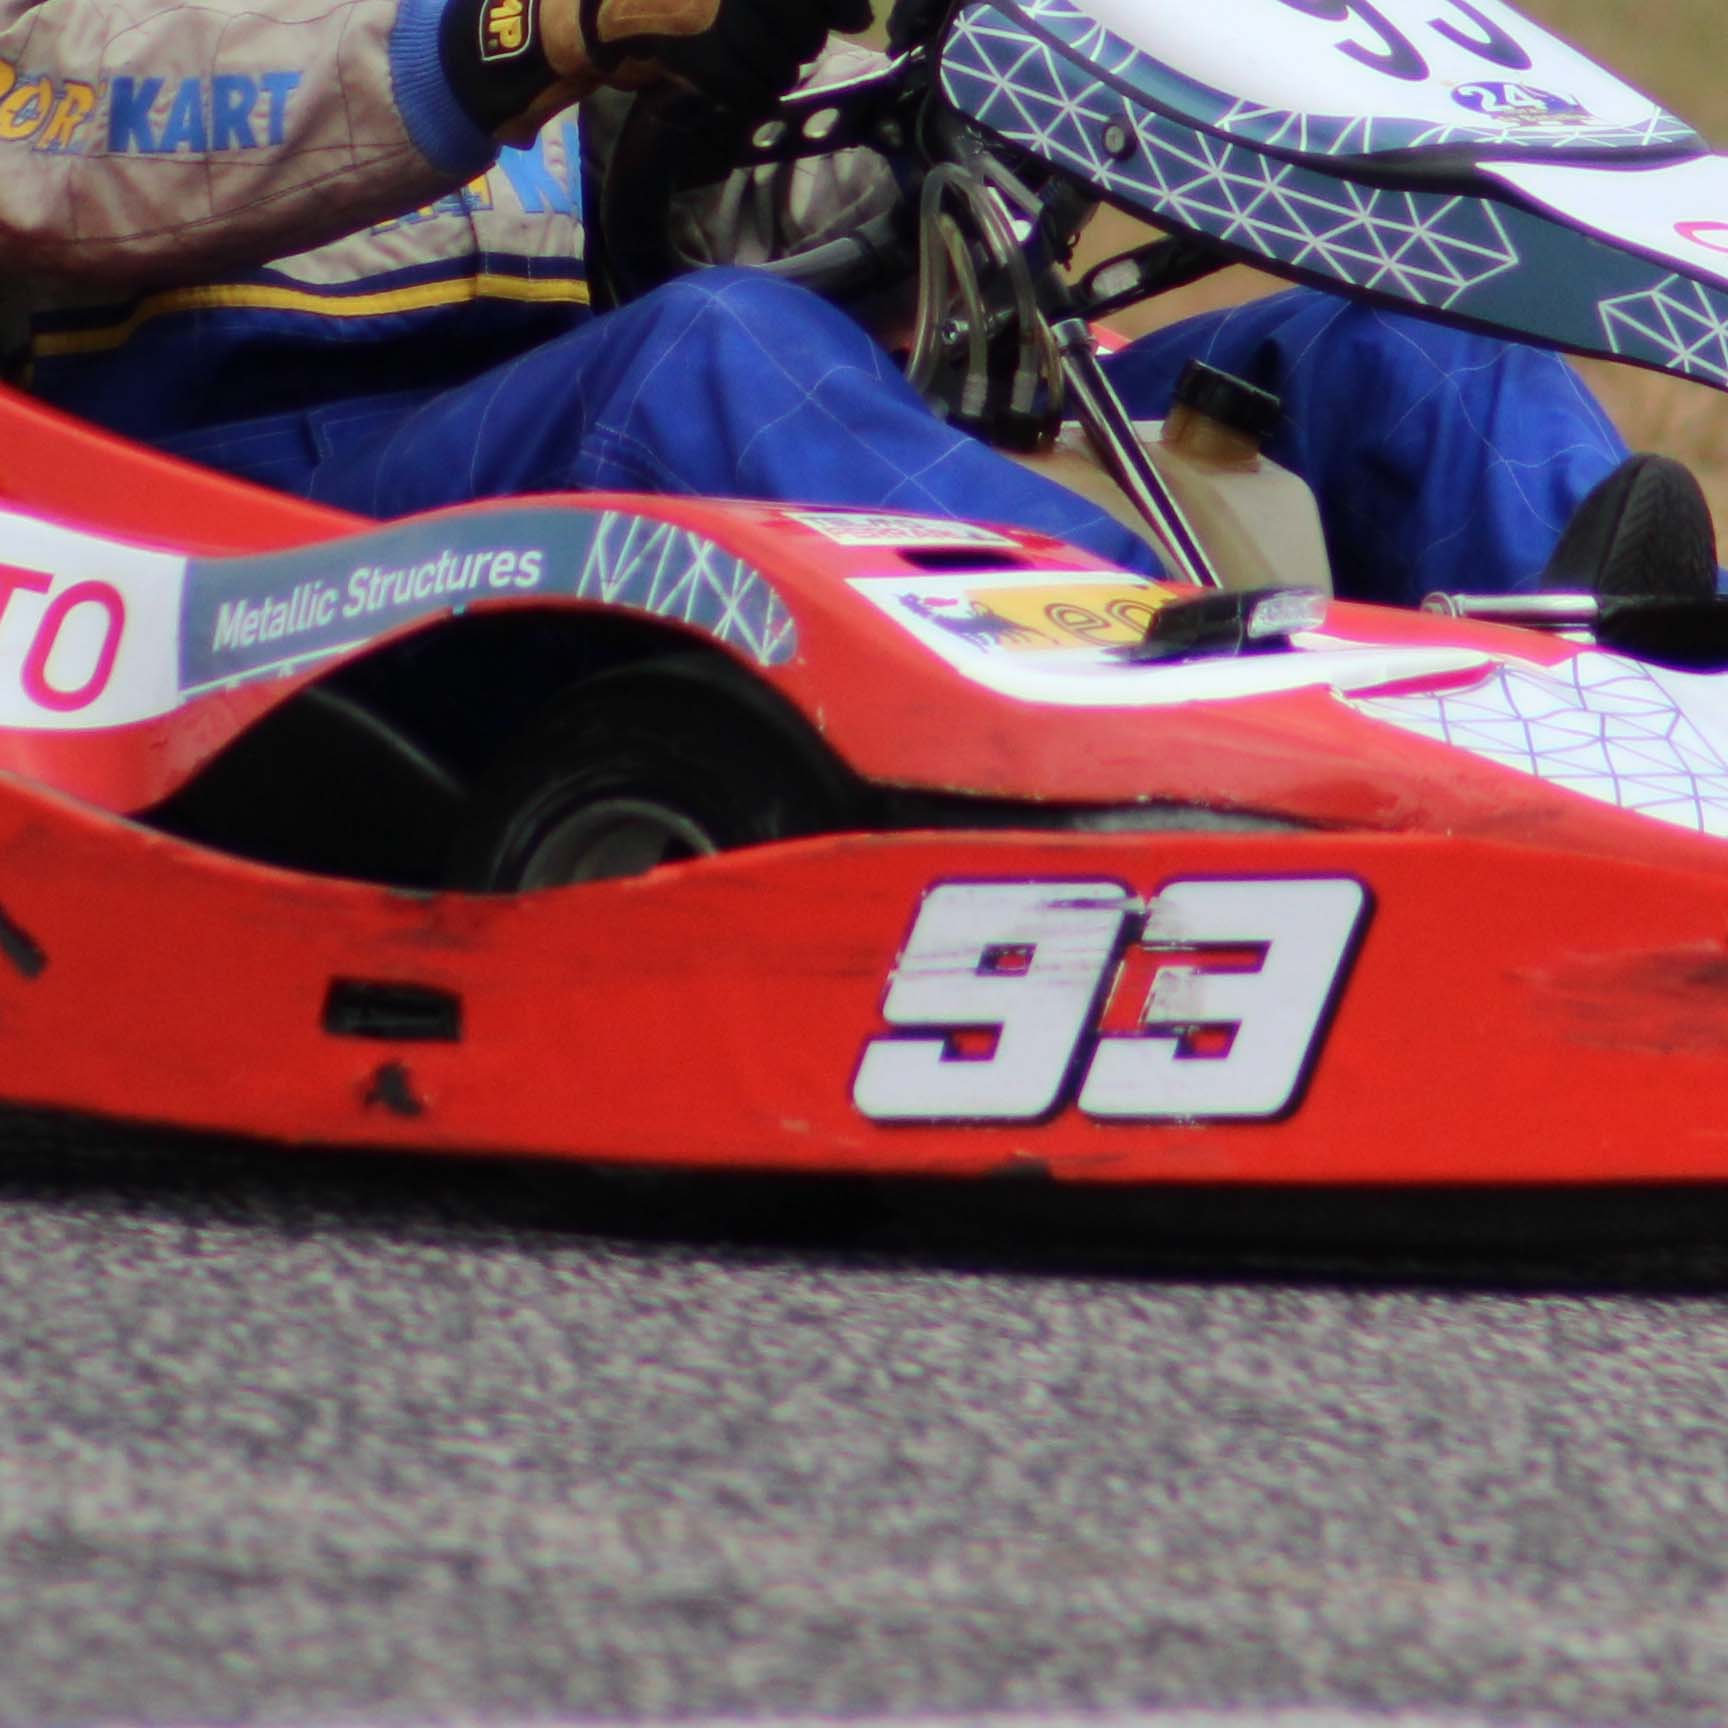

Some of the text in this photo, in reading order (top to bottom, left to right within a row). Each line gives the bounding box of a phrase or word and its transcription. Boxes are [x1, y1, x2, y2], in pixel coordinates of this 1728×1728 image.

[106, 70, 304, 154] KART
[212, 548, 543, 653] Metallic Structures
[848, 871, 1377, 1128] 93
